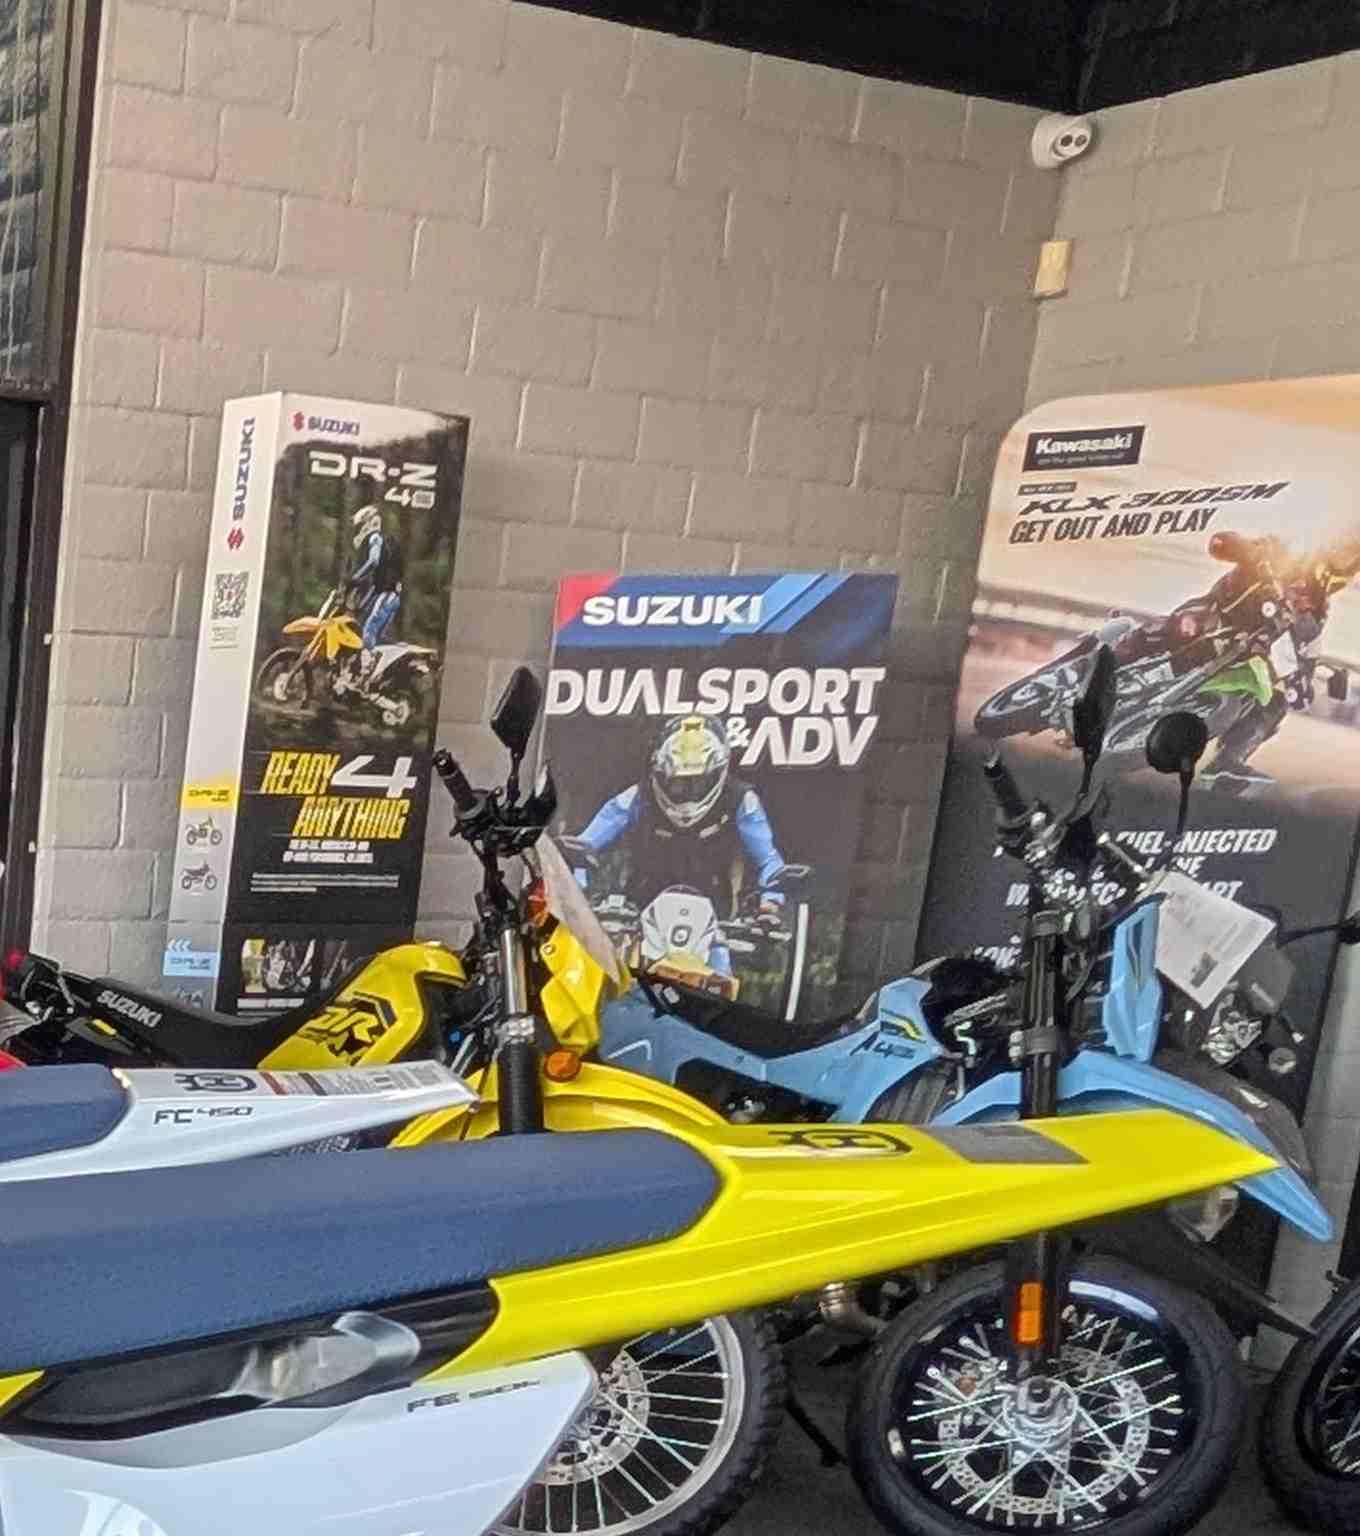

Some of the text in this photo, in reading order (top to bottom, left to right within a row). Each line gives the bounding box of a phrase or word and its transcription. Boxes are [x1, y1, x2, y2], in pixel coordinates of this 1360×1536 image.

[308, 416, 360, 436] SUZUKI
[1035, 433, 1134, 455] Kawasaki
[232, 417, 255, 521] SUZUKI
[1018, 495, 1121, 516] KLX
[1009, 507, 1217, 545] GET OUT AND PLAY
[582, 595, 764, 627] SUZUKI
[259, 751, 418, 799] READY 4
[291, 796, 411, 840] ANYTHING
[96, 990, 163, 1029] SUZUKI
[153, 1108, 194, 1125] FC
